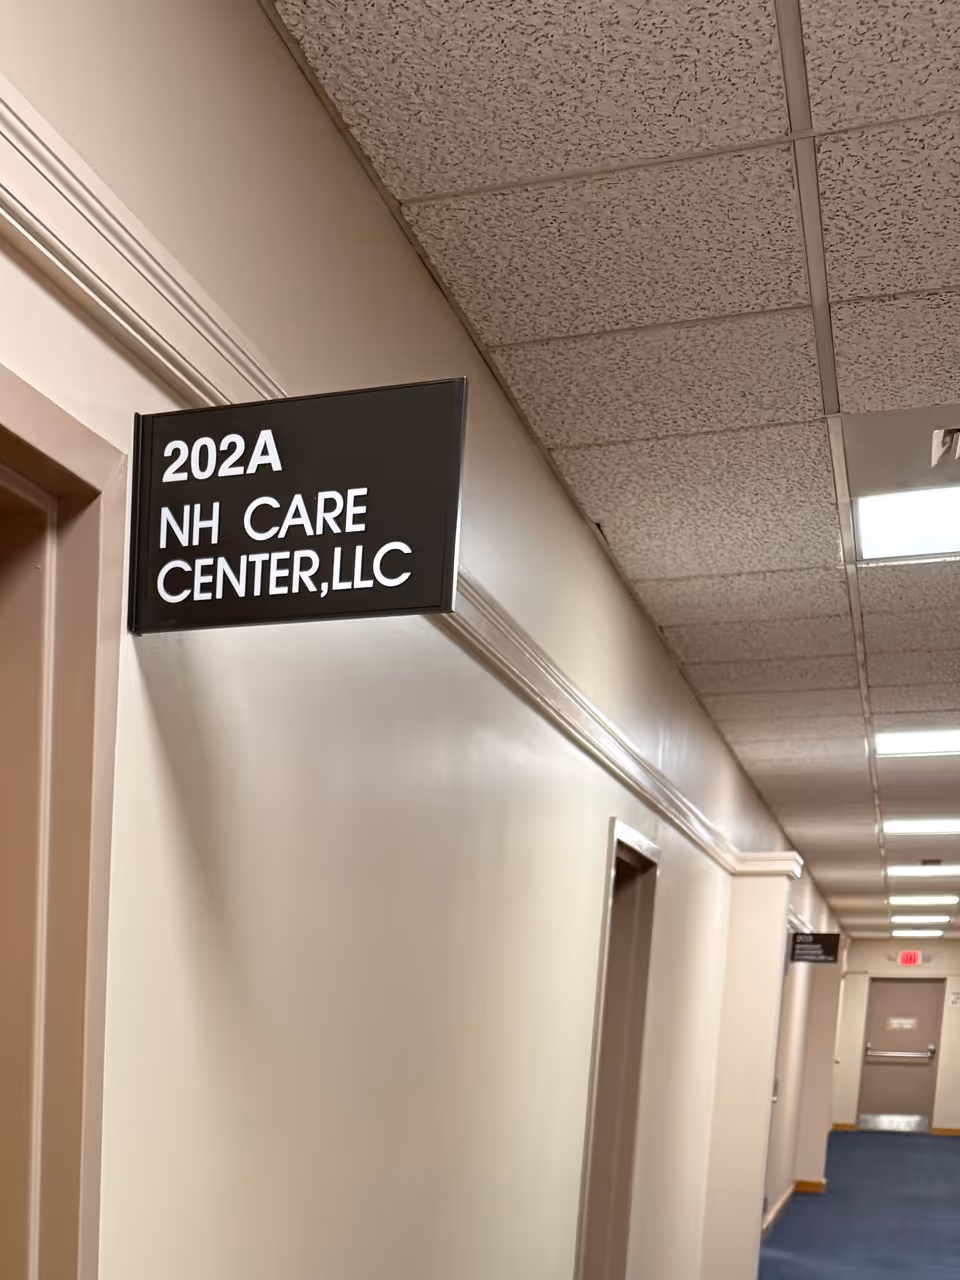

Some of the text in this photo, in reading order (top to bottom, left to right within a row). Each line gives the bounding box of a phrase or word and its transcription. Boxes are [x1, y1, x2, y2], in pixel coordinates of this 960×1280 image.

[162, 429, 283, 483] 202A
[159, 487, 368, 549] NH CARE
[156, 541, 413, 604] CENTER,LLC
